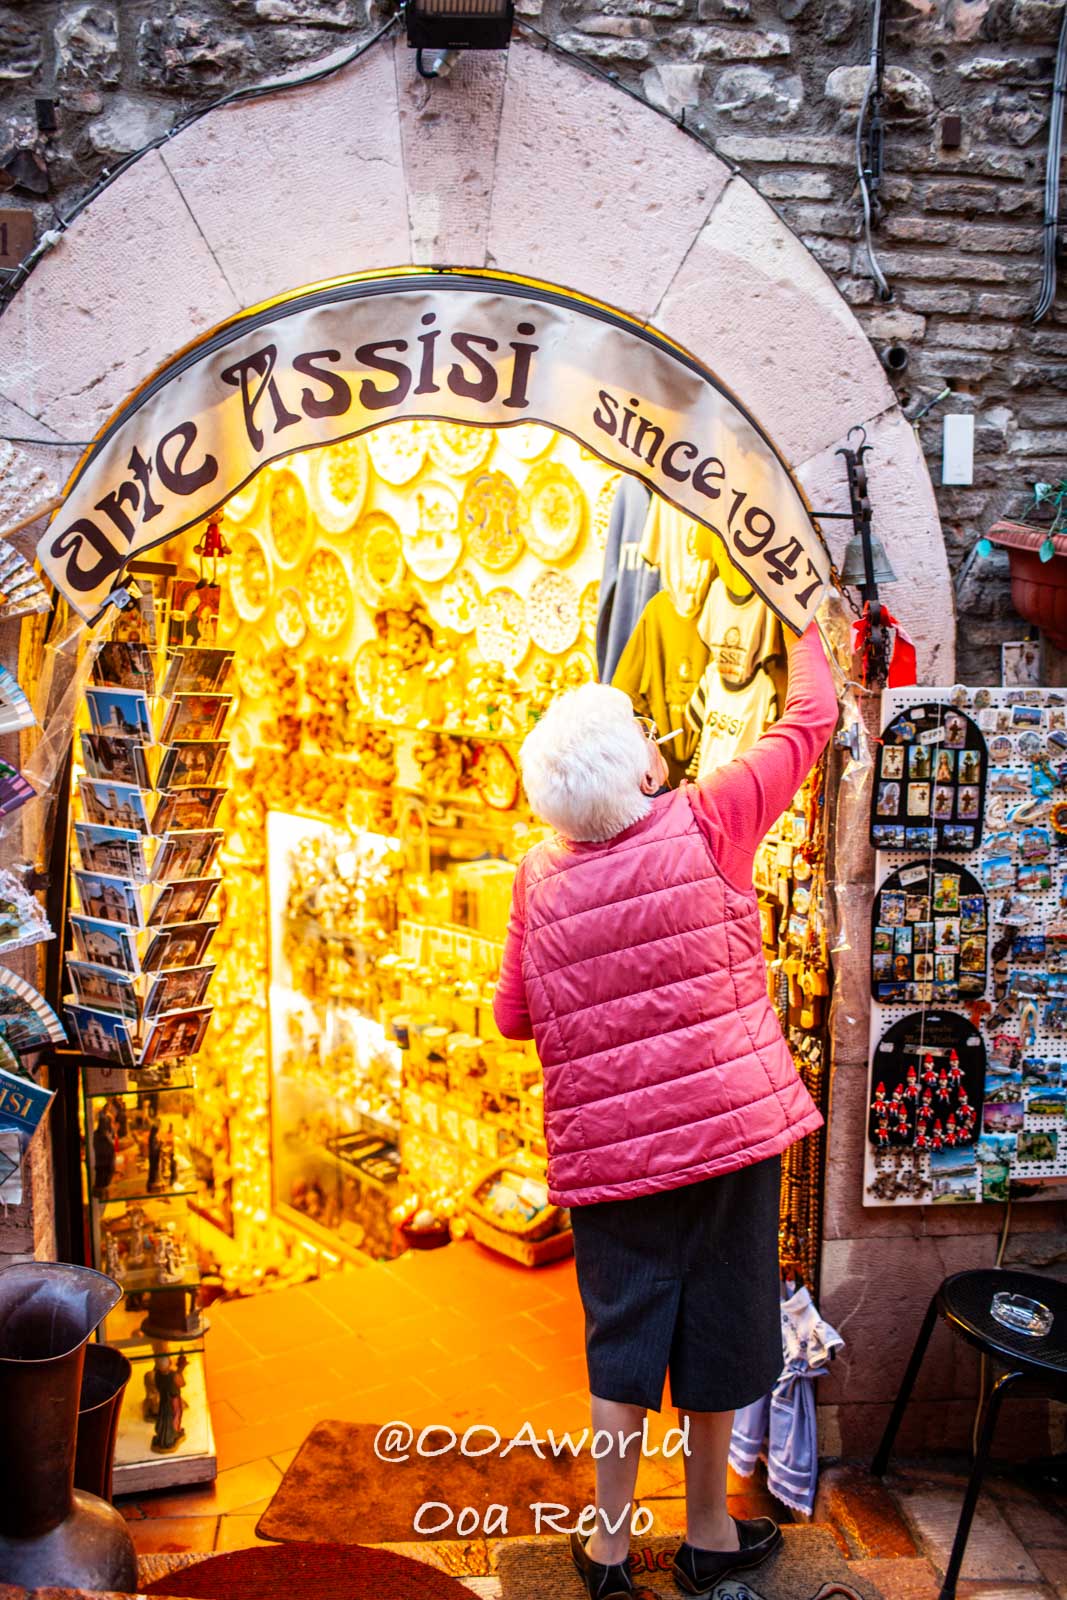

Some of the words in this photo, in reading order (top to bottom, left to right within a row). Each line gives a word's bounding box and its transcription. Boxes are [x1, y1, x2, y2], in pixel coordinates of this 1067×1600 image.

[50, 421, 219, 593] arte
[220, 312, 540, 452] Assisi
[593, 390, 726, 500] since
[727, 488, 824, 610] 1947
